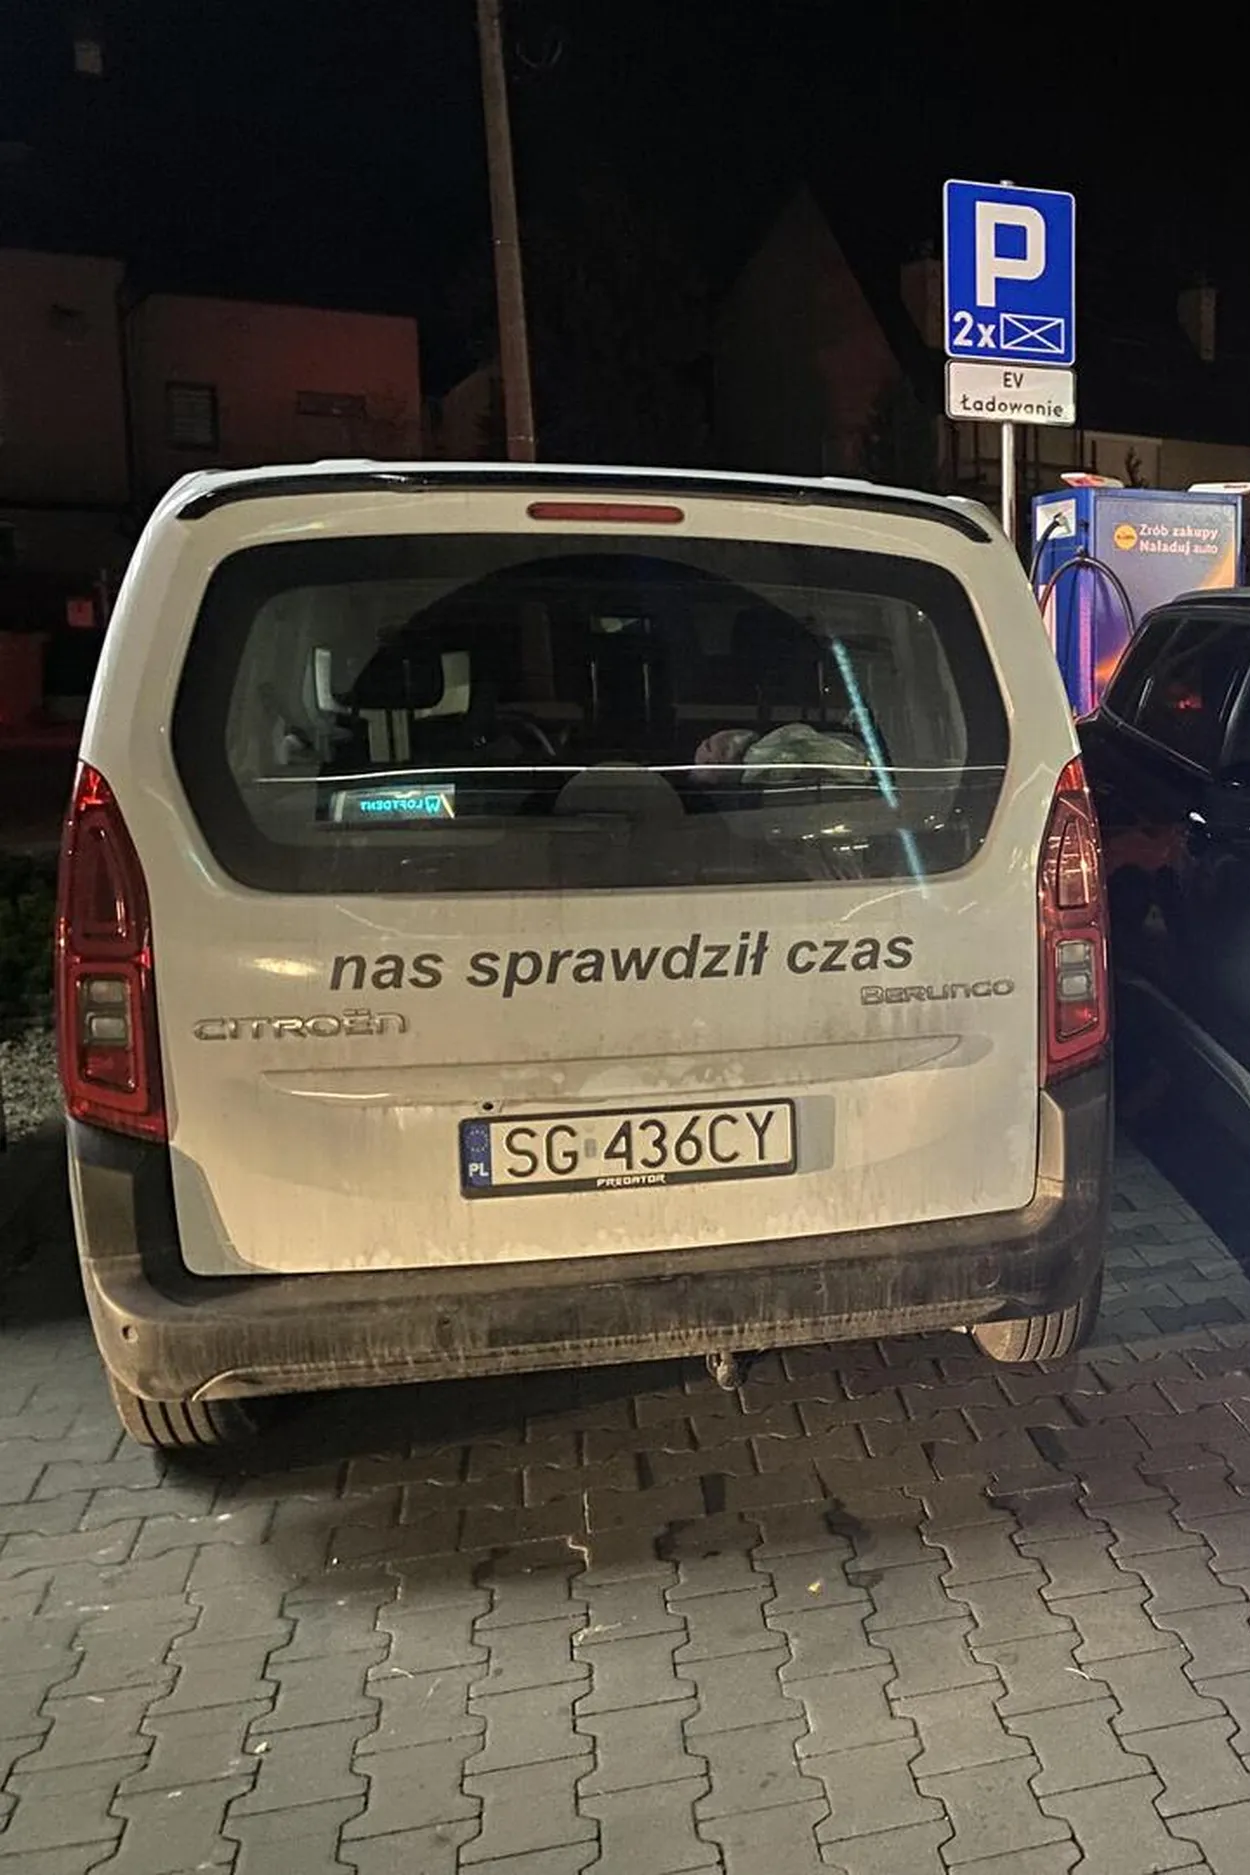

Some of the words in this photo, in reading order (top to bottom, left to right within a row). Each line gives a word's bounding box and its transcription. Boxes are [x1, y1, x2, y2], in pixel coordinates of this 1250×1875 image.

[975, 200, 1046, 307] P
[953, 311, 996, 348] 2x
[1003, 371, 1024, 388] EV
[960, 394, 1063, 417] Ładowanie
[1139, 523, 1169, 537] Zrób
[1172, 525, 1219, 540] zakupy
[1192, 543, 1219, 554] auto
[329, 953, 445, 991] nas
[466, 931, 769, 999] sprawdził
[786, 935, 914, 975] czas
[503, 1124, 579, 1179] SG
[603, 1110, 776, 1171] 436CY
[468, 1162, 489, 1177] PL
[596, 1173, 667, 1189] PREDATOR
